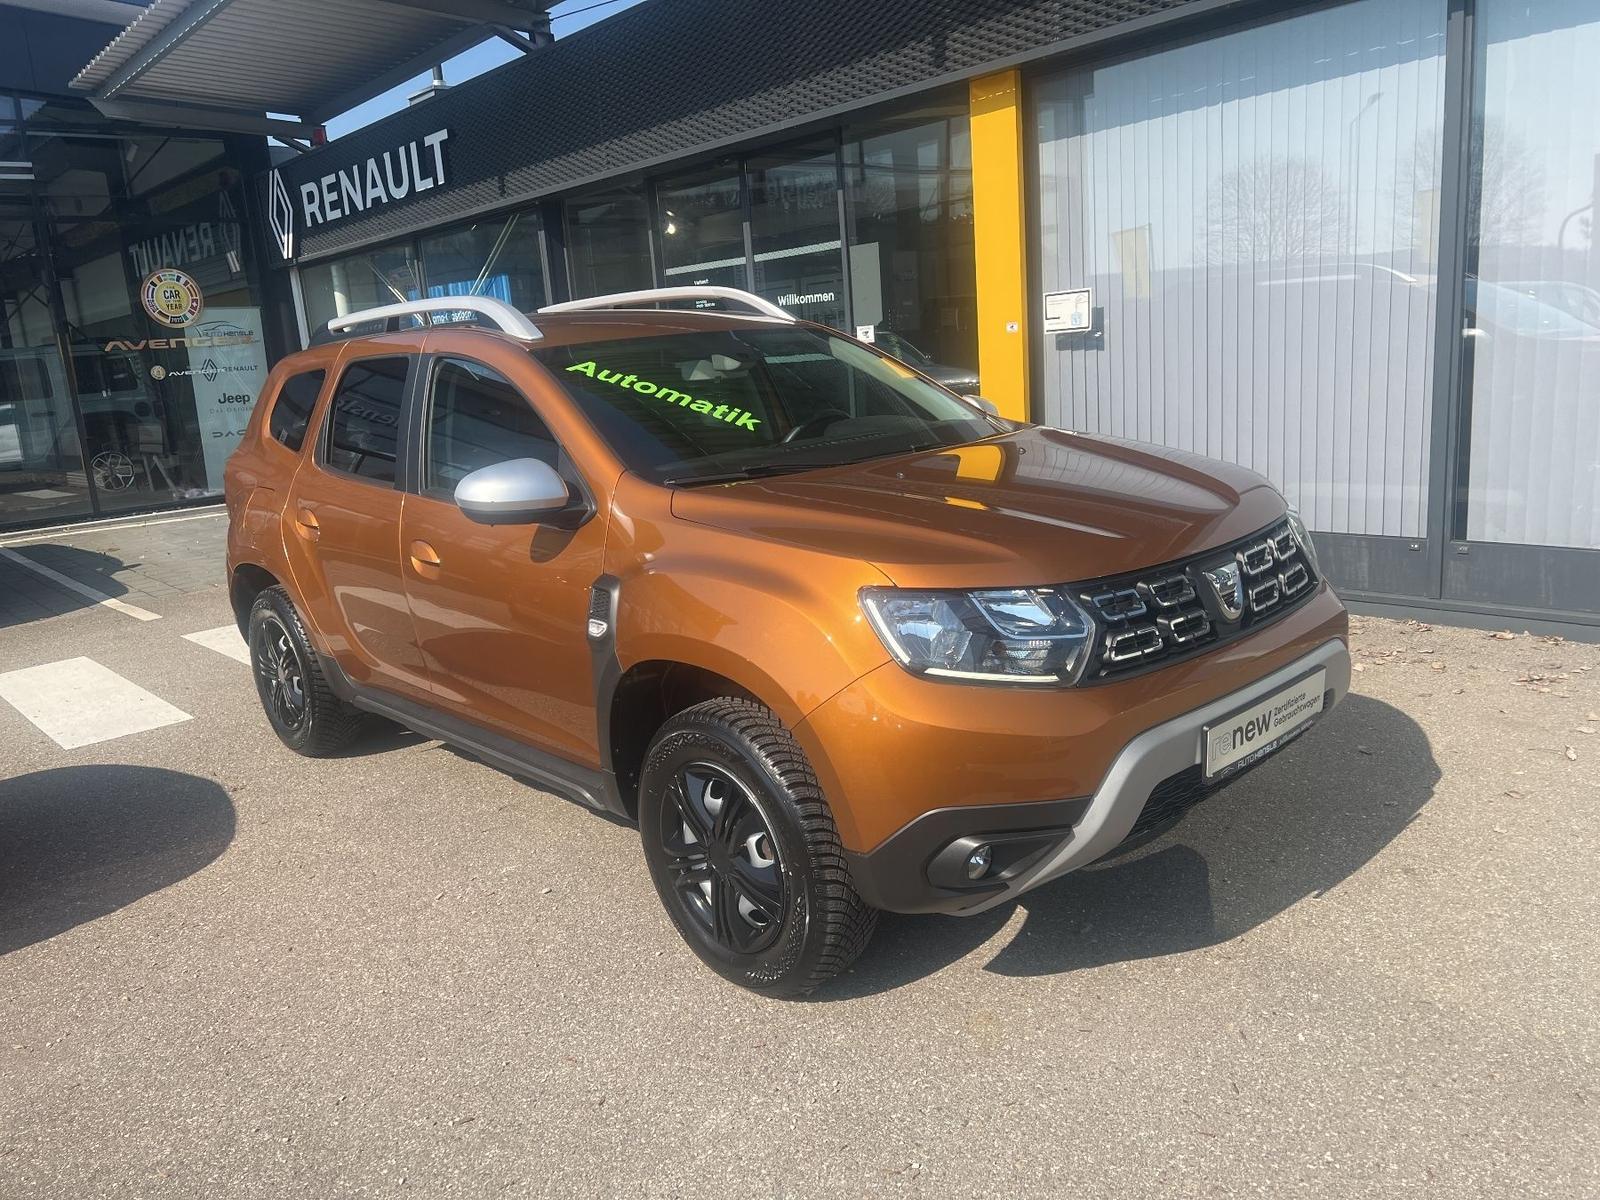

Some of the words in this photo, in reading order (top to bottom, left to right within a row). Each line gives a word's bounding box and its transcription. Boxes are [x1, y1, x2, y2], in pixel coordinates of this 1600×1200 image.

[300, 128, 448, 228] RENAULT
[163, 289, 181, 300] CAR
[777, 291, 835, 307] Willkommen
[165, 303, 183, 311] YEAR
[218, 392, 251, 405] Jeep
[565, 360, 762, 432] Automatik
[1209, 711, 1272, 762] renew
